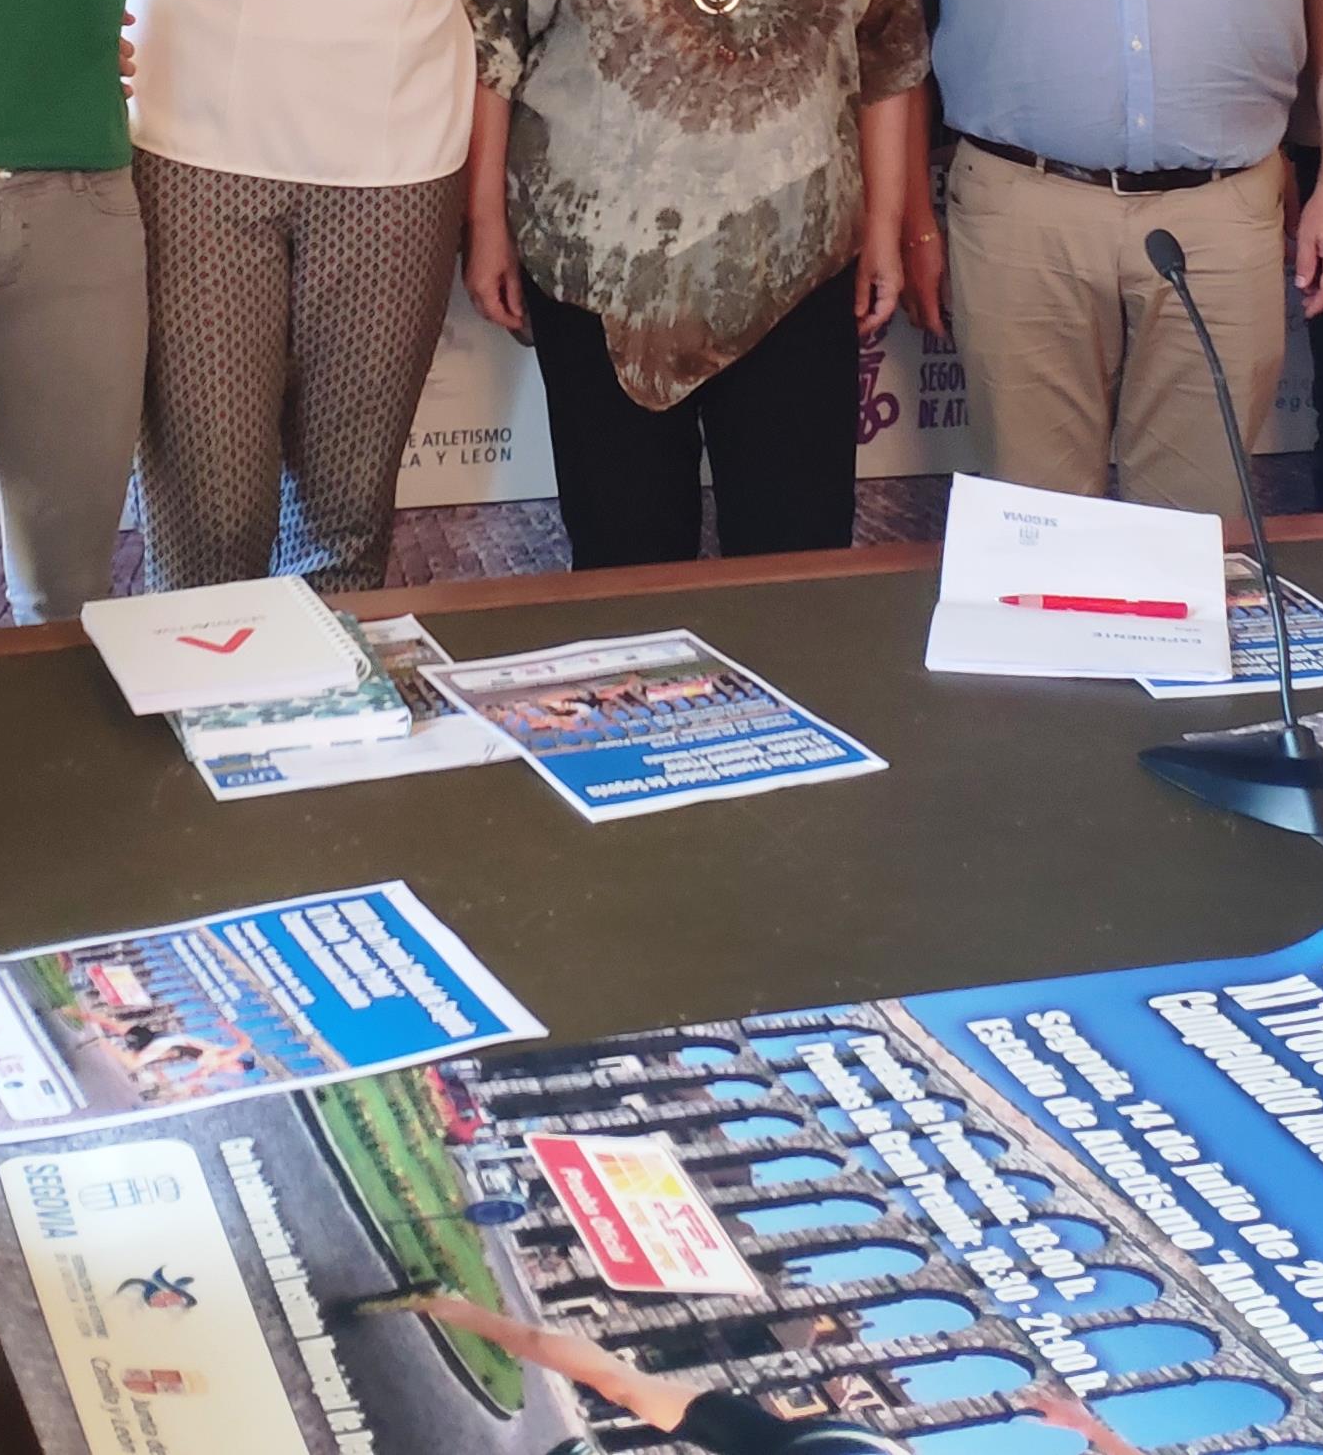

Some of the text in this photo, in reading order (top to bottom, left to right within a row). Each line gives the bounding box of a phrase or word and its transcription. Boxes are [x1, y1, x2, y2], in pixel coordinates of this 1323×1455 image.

[423, 427, 512, 448] ATLETISMO
[1025, 1008, 1135, 1103] Segovia,
[966, 1017, 1068, 1098] Estadio
[1042, 1096, 1099, 1130] de
[1072, 1129, 1216, 1251] Atletismo
[1116, 1100, 1175, 1130] 14
[1142, 1128, 1202, 1163] de
[22, 1163, 79, 1240] SEGOVIA
[1170, 1162, 1262, 1223] julio
[1009, 1222, 1087, 1279] 18:00
[1237, 1222, 1300, 1260] de
[963, 1245, 1040, 1303] 18:30
[1016, 1311, 1098, 1374] 21:00
